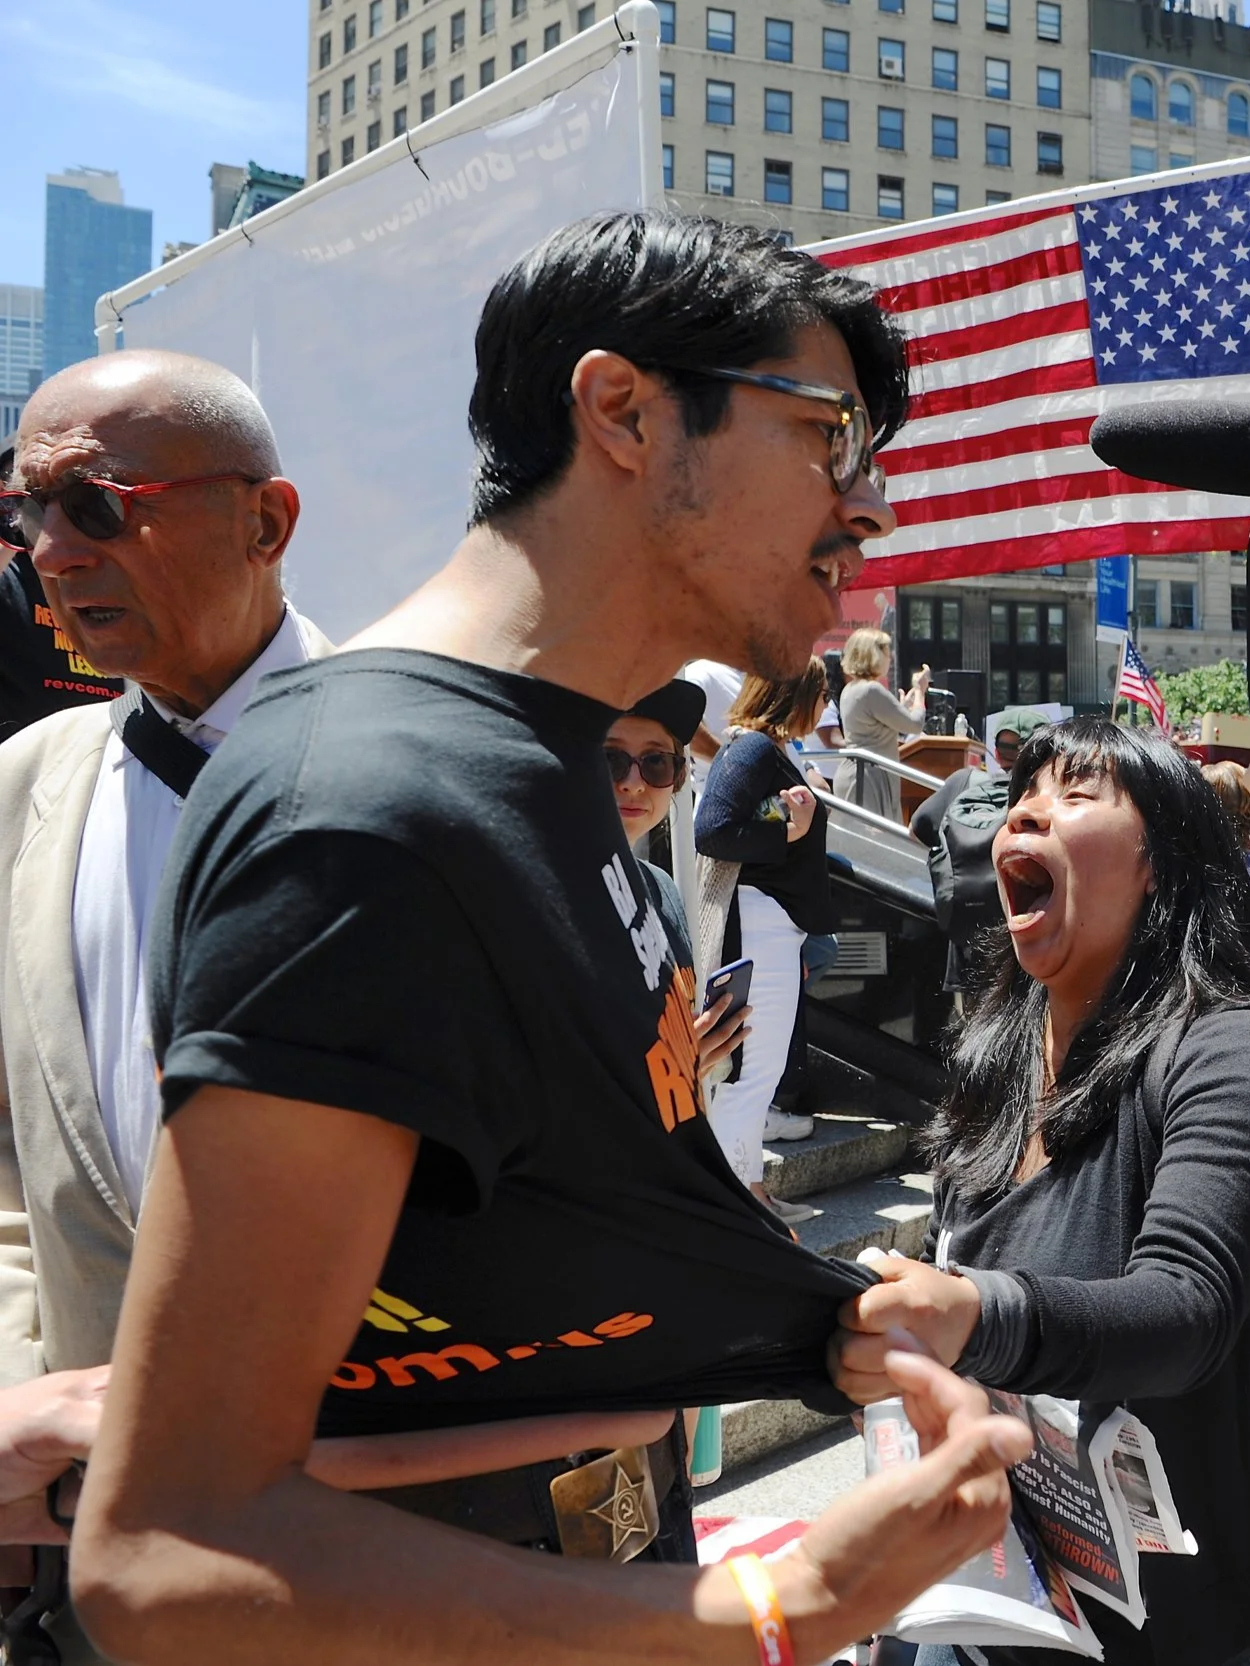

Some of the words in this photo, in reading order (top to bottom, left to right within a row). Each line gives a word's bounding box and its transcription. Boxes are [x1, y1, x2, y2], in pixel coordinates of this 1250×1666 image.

[43, 679, 124, 698] revcom.u
[1046, 1477, 1057, 1491] Is
[1060, 1487, 1092, 1511] ALSO
[1053, 1465, 1098, 1499] Fascist
[1015, 1467, 1038, 1487] War
[1041, 1483, 1082, 1514] Crimes
[1085, 1512, 1108, 1532] and
[1055, 1502, 1111, 1545] Humanity
